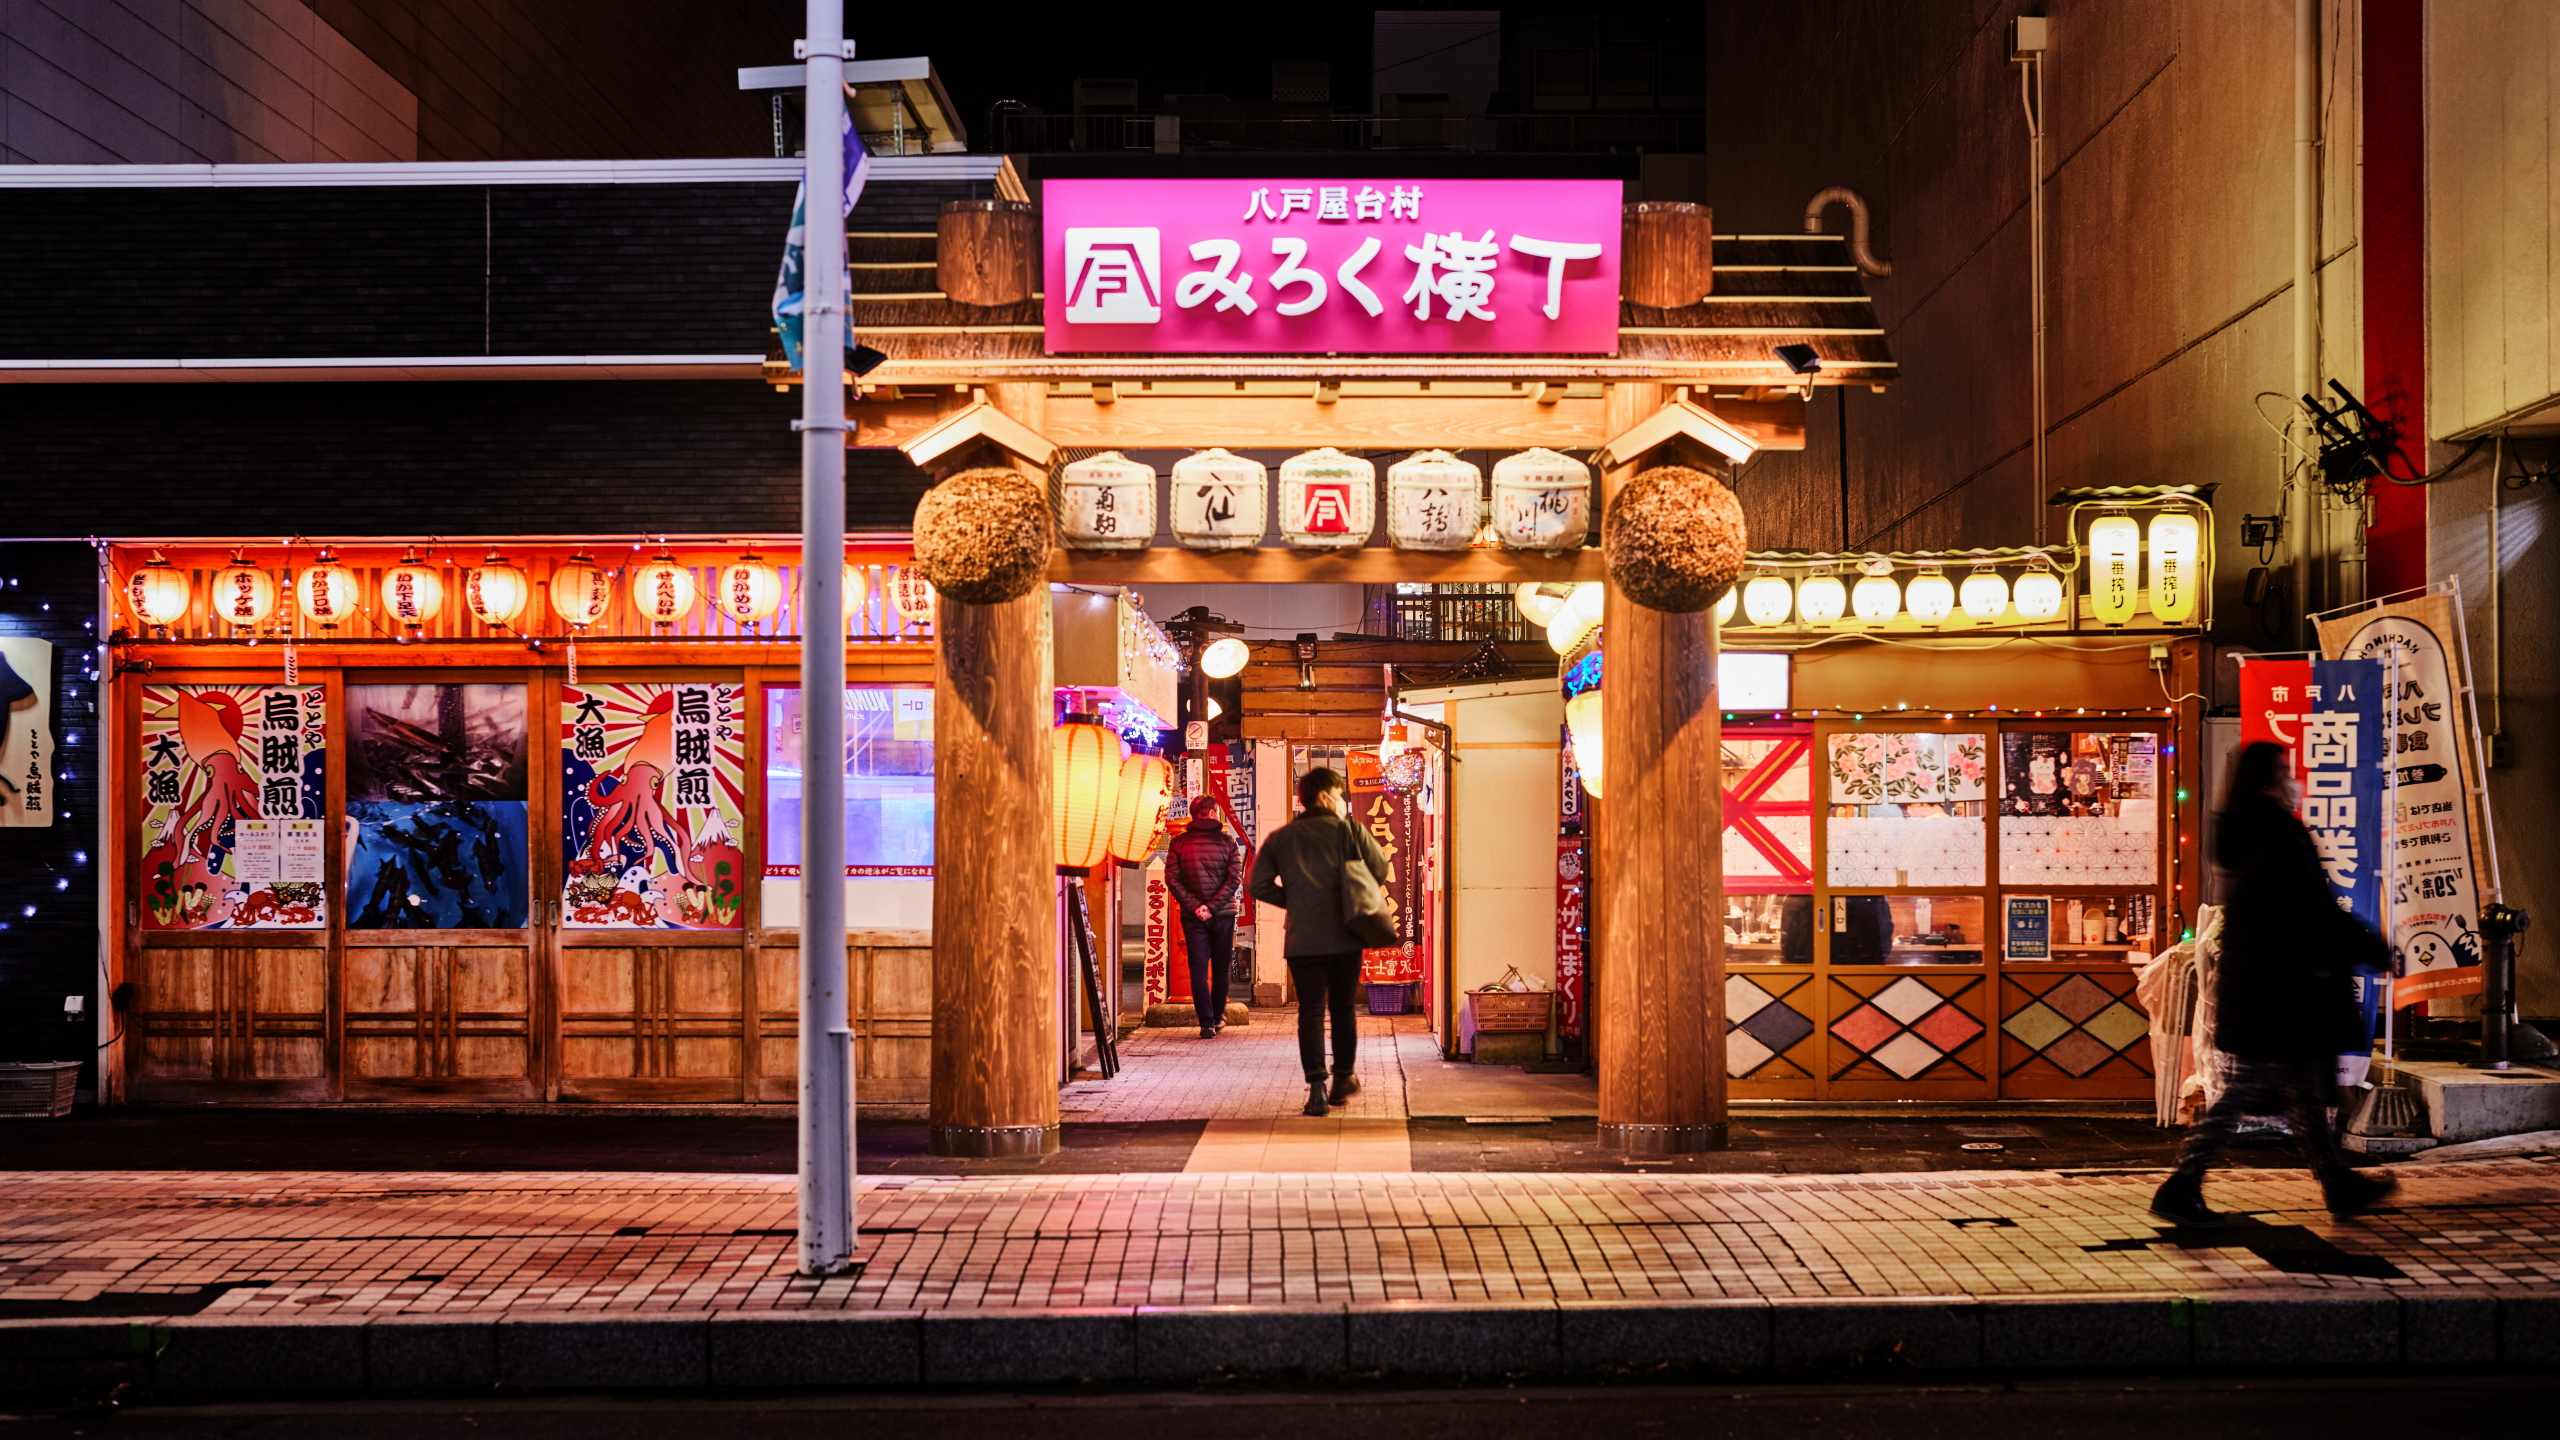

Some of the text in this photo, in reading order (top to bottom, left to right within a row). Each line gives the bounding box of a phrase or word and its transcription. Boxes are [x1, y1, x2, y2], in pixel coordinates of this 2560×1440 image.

[1243, 186, 1424, 222] 八戸屋台村
[1175, 229, 1602, 321] みろく横丁
[234, 572, 254, 616] ホッケ焼
[312, 571, 333, 615] いかゴロ焼
[656, 571, 676, 615] せんべい汁
[733, 569, 751, 614] いかめし
[2112, 553, 2124, 609] 一番搾り
[2164, 551, 2177, 607] 一番搾り
[305, 691, 323, 749] ととや
[575, 694, 606, 759] 大漁
[716, 687, 732, 741] ととや
[149, 735, 181, 803] 大漁
[262, 691, 299, 816] 烏賊煎
[676, 688, 711, 805] 烏賊煎
[1564, 766, 1573, 812] カメヤマ
[1836, 902, 1845, 924] 入口
[1146, 880, 1167, 1005] みろくロマンポスト
